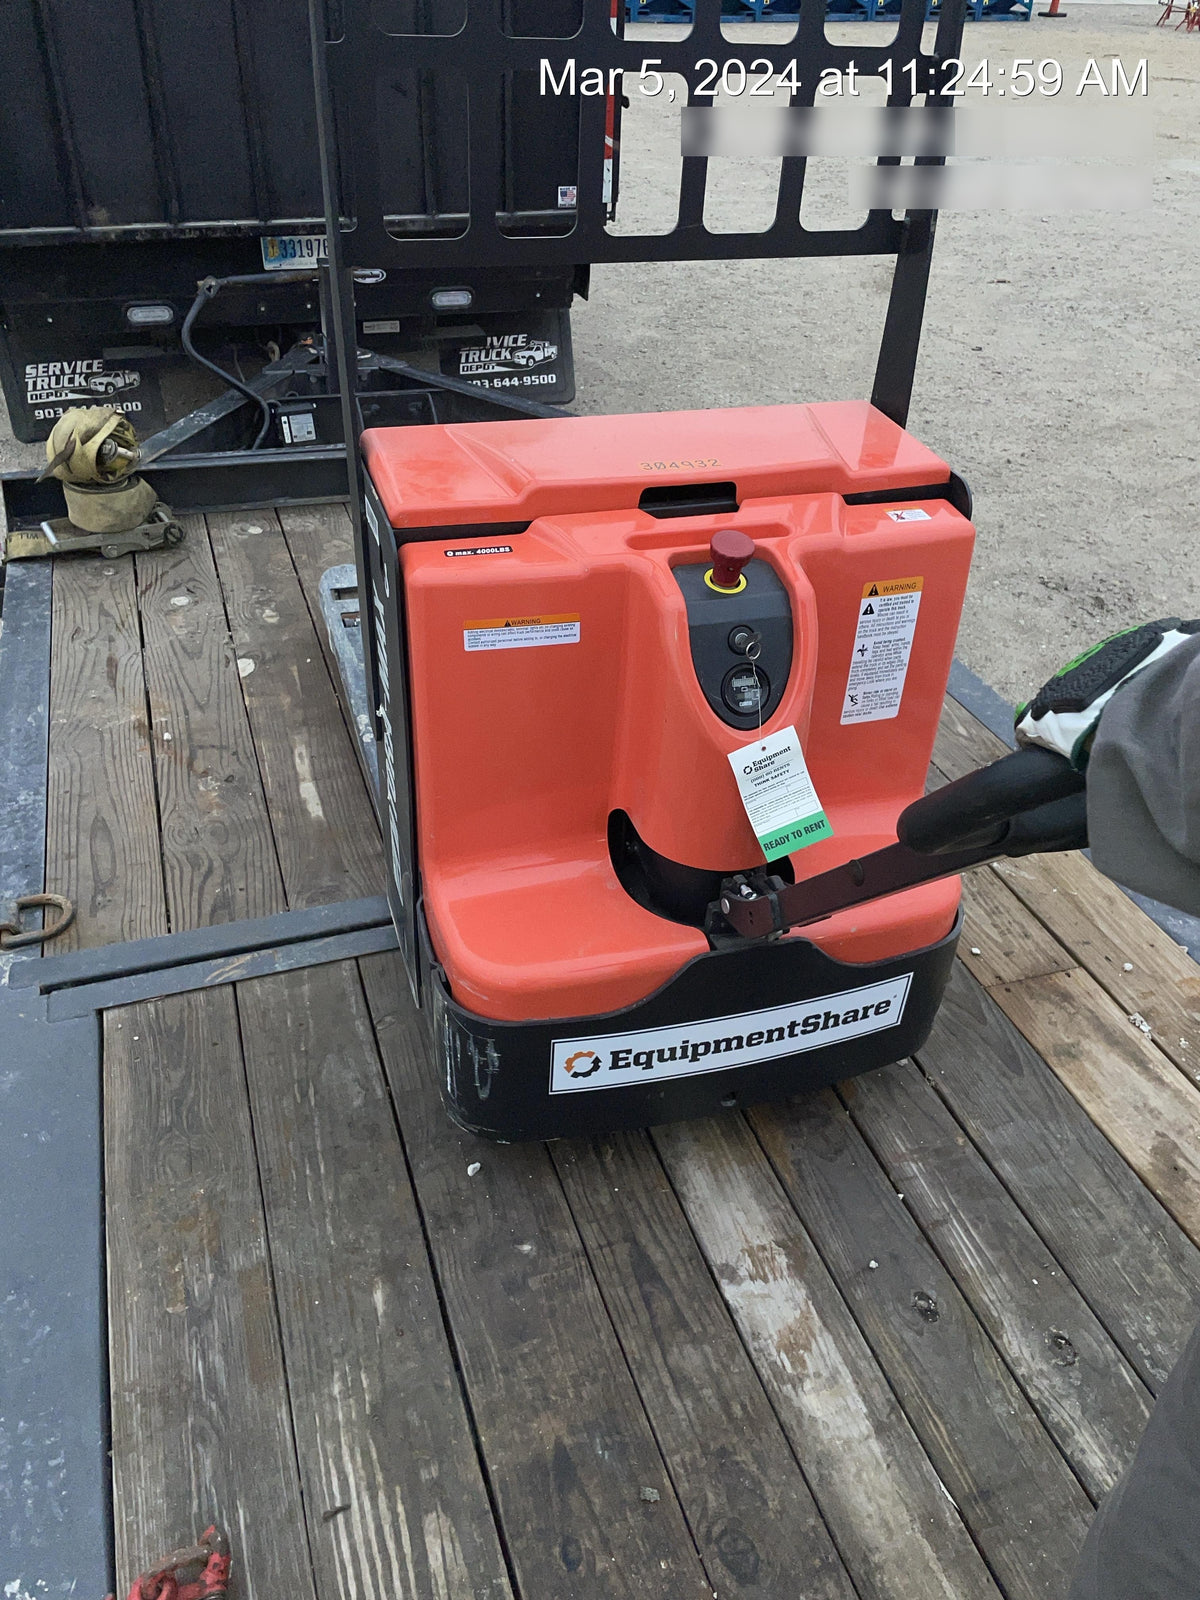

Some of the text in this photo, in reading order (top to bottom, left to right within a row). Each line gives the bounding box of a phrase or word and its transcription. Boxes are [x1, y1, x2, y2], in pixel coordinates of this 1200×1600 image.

[459, 347, 512, 363] TRUCK
[25, 360, 104, 378] SERVICE
[25, 374, 88, 391] TRUCK
[640, 459, 721, 471] 304932
[476, 546, 511, 554] 4000LBS
[883, 582, 917, 593] WARNING
[512, 618, 541, 626] WARNING
[752, 746, 791, 767] Equipment
[754, 760, 775, 772] Share
[754, 769, 790, 787] THINK SAFETY
[763, 819, 826, 852] READY TO RENT
[608, 998, 892, 1071] EquipmentShare
